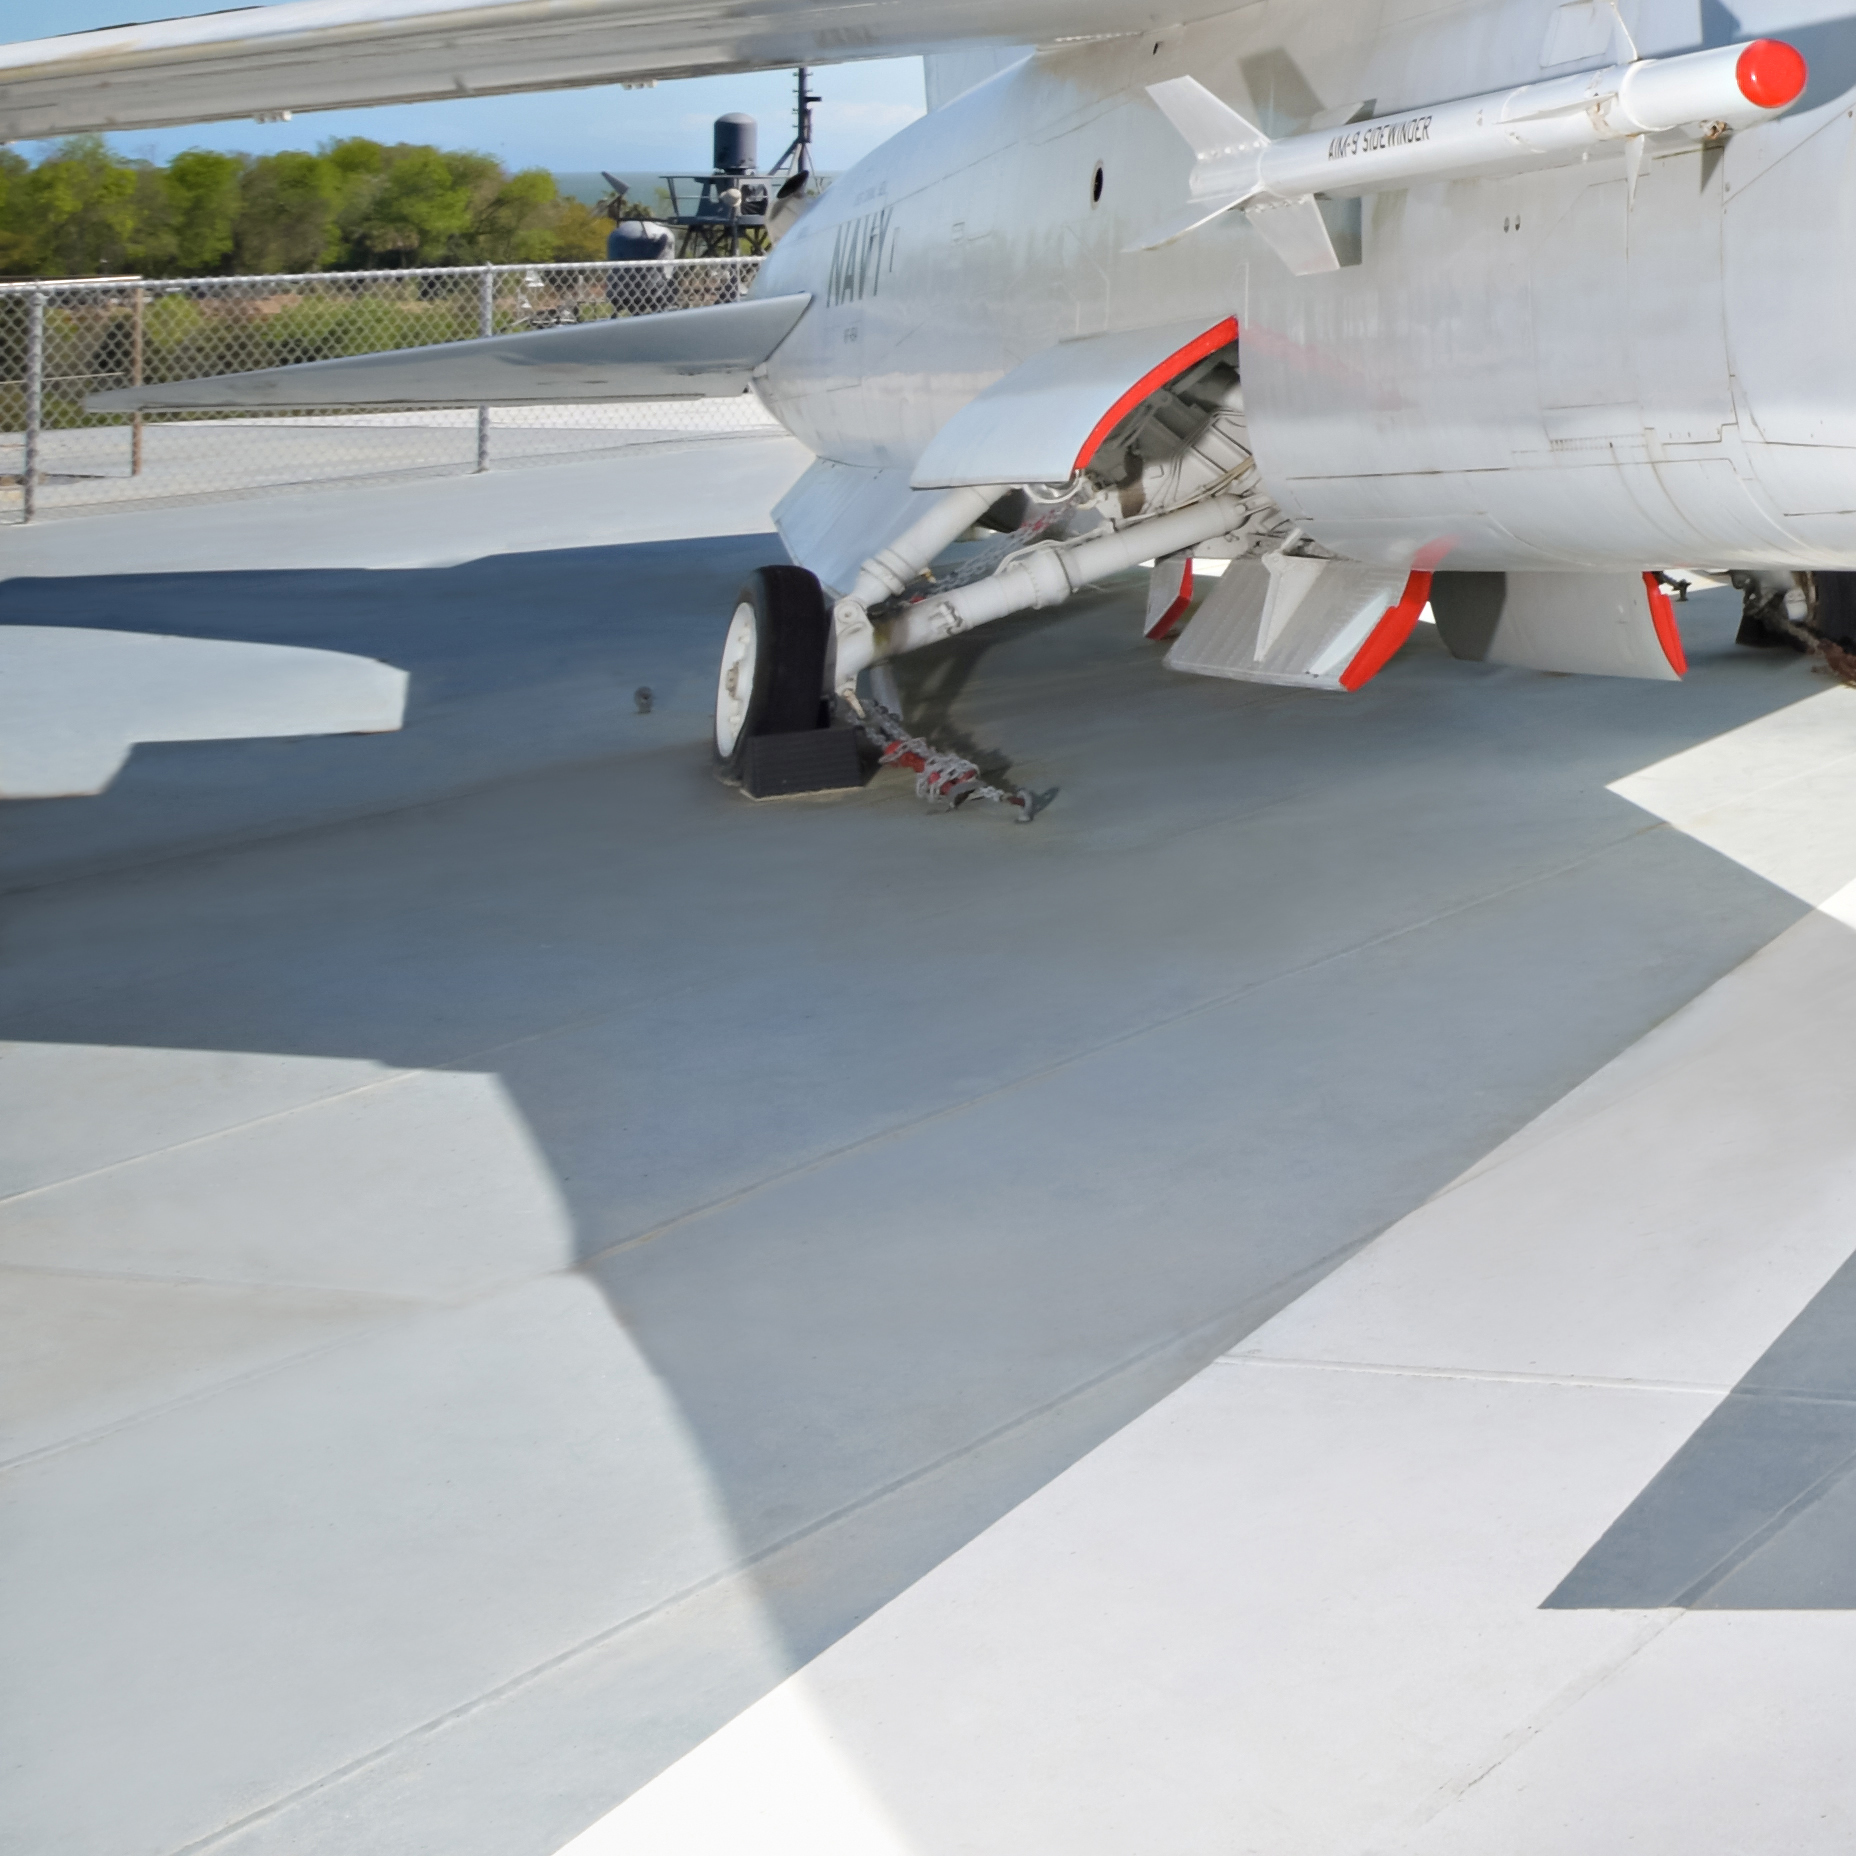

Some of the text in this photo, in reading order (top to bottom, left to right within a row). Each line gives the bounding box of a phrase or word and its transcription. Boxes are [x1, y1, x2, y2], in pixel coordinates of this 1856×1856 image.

[1328, 116, 1433, 161] AIM-9 SIDEWINDER
[827, 207, 894, 308] NAVY
